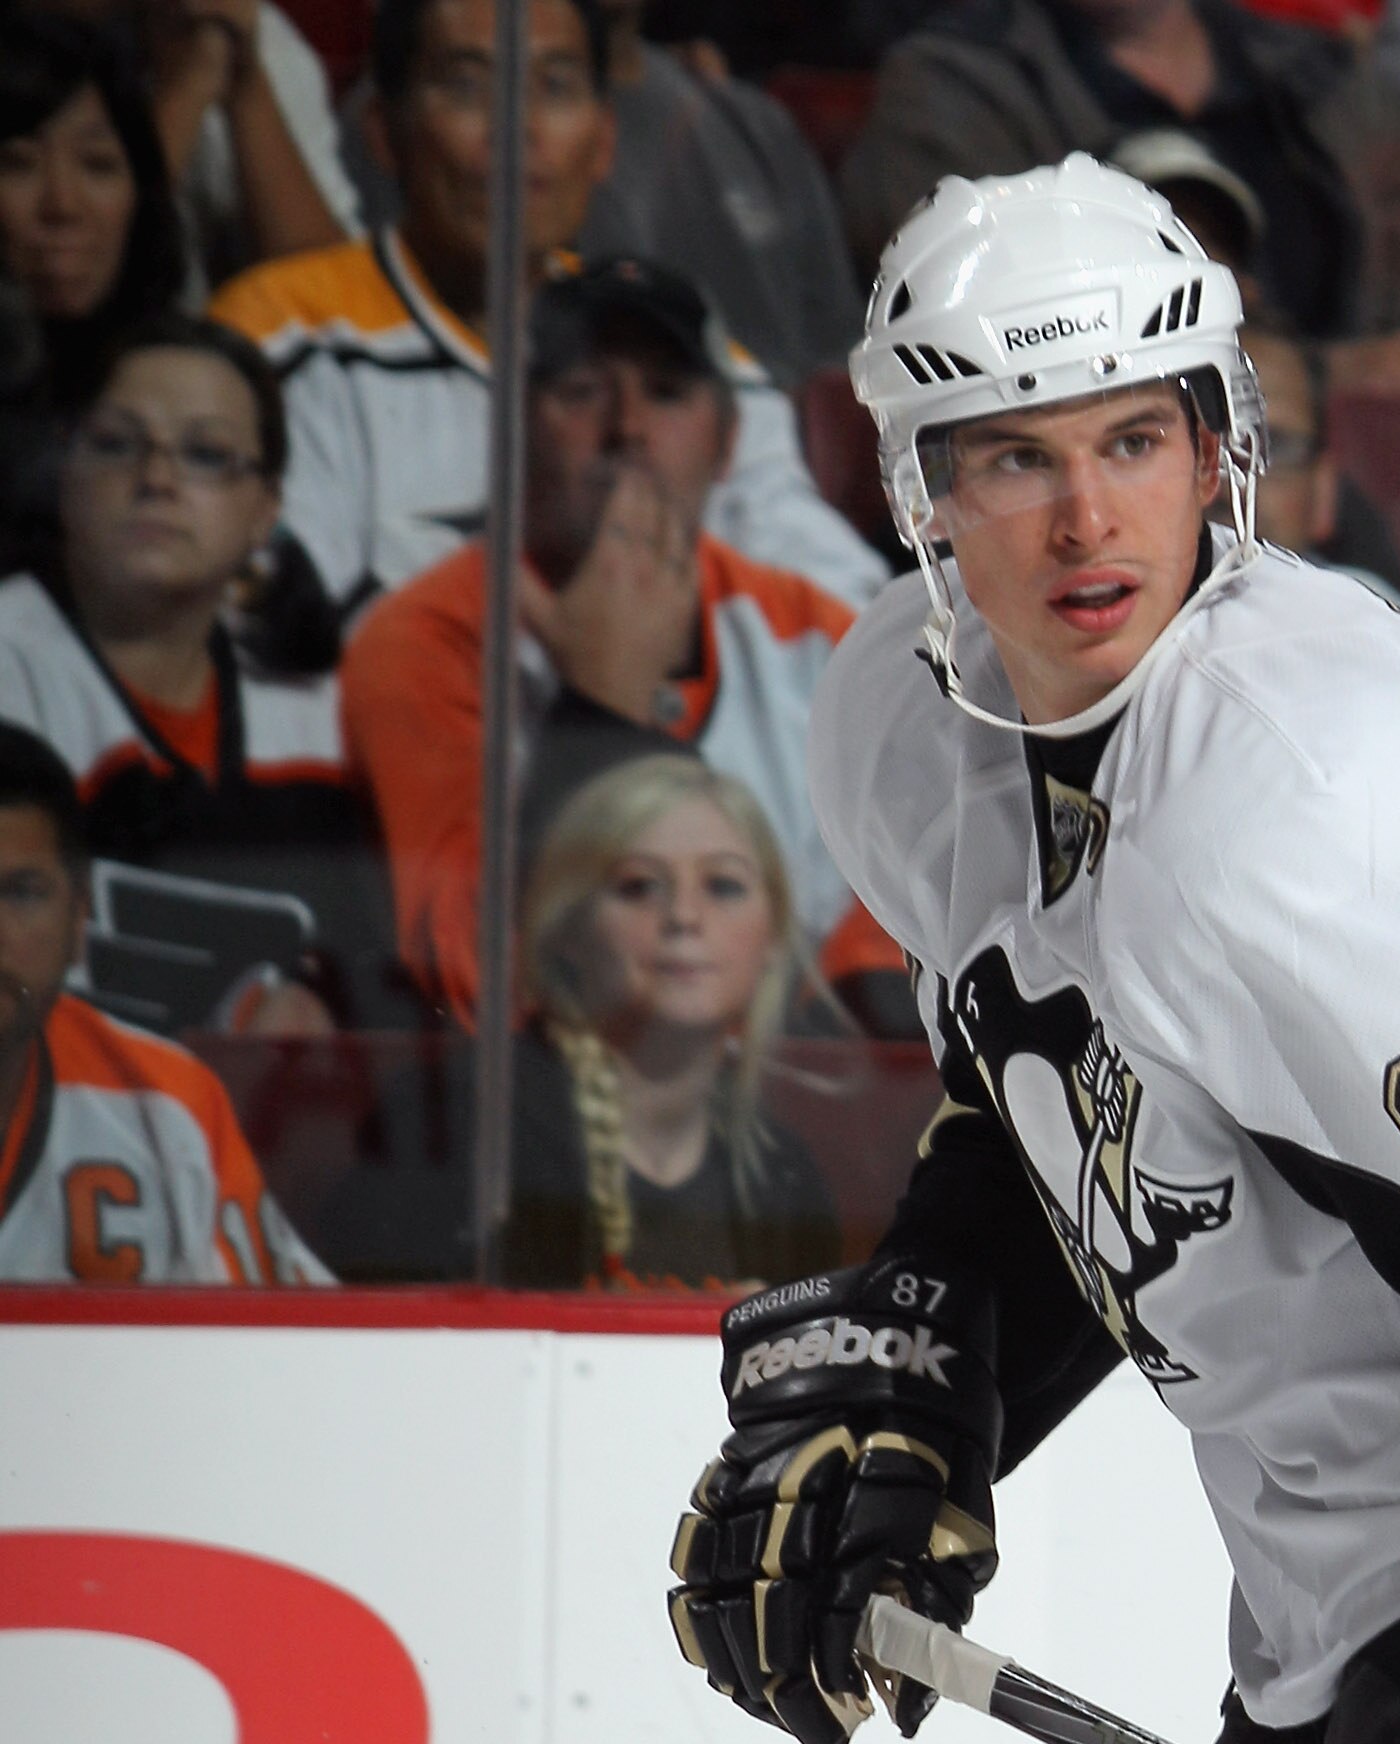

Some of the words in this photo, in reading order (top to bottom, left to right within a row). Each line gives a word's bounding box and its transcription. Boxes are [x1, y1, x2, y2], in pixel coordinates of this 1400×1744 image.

[1003, 309, 1110, 352] Reebok
[64, 1158, 143, 1285] C
[726, 1276, 832, 1330] PENGUINS
[890, 1271, 948, 1315] 87
[730, 1314, 959, 1400] Reebok
